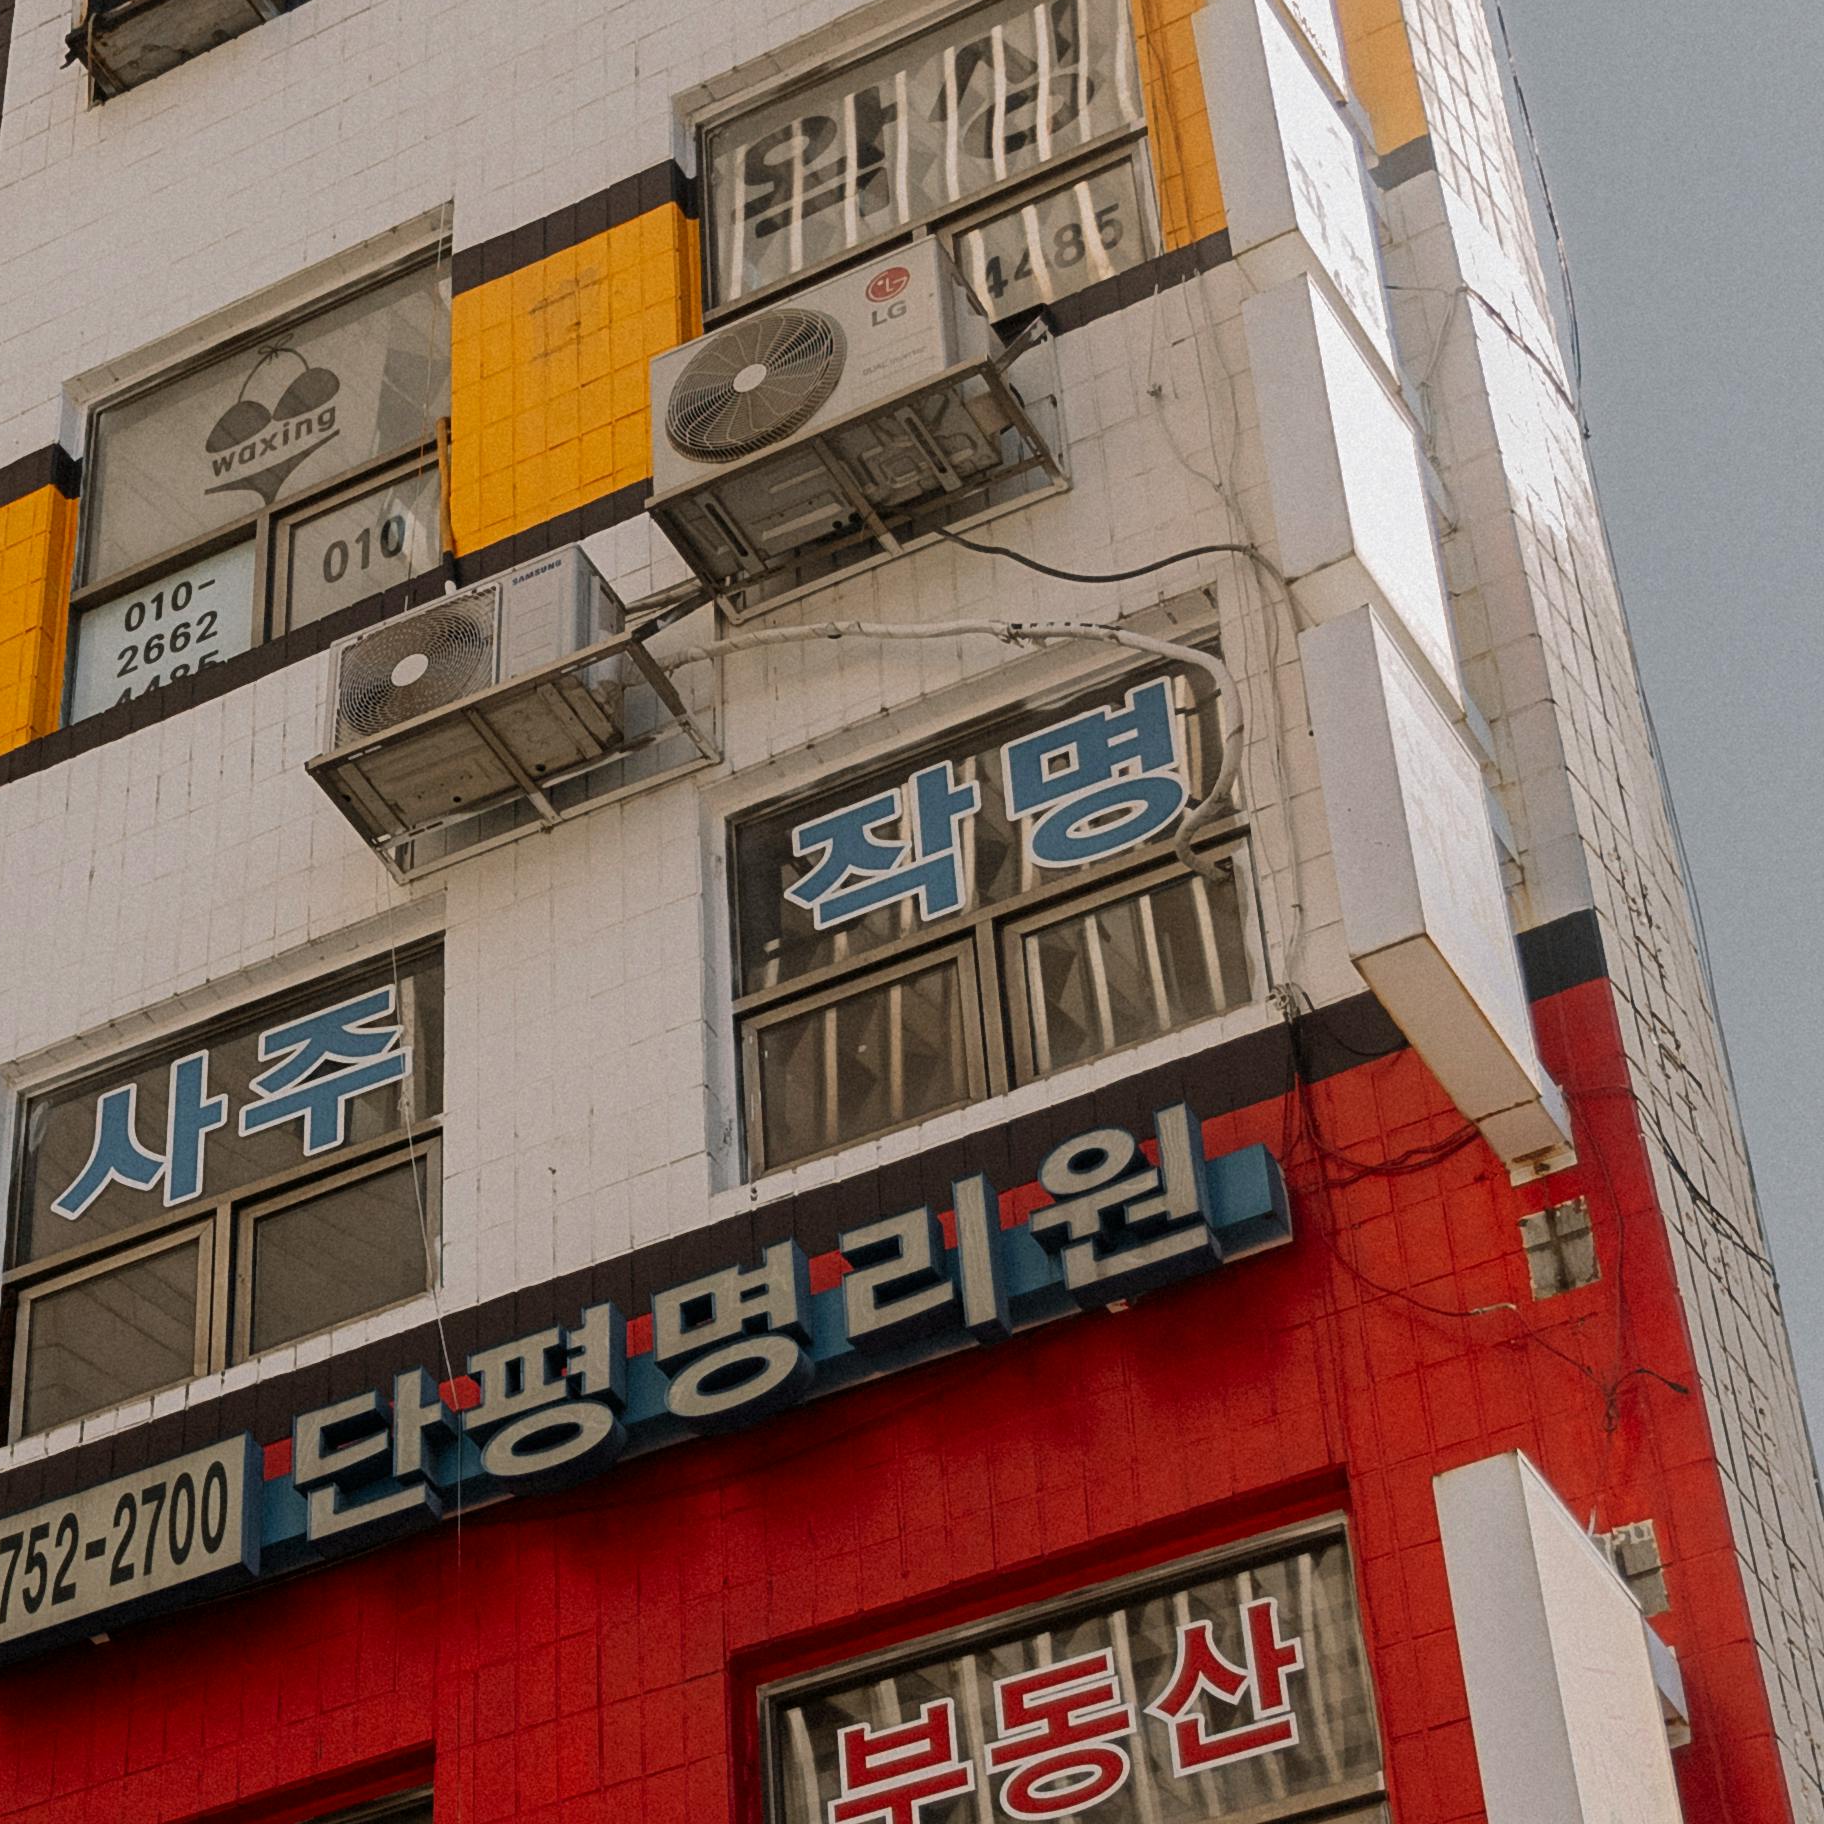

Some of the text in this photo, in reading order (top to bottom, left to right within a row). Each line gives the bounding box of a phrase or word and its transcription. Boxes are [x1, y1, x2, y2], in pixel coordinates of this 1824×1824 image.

[985, 202, 1124, 301] 4485
[871, 299, 908, 328] LG
[212, 406, 336, 477] waxing
[323, 515, 406, 583] 010
[511, 559, 562, 586] SAMSUNG
[124, 578, 216, 632] 010-
[116, 610, 218, 678] 2662
[784, 676, 1193, 930] 작명
[49, 984, 408, 1222] 사주
[292, 1102, 1222, 1544] 단평명리원
